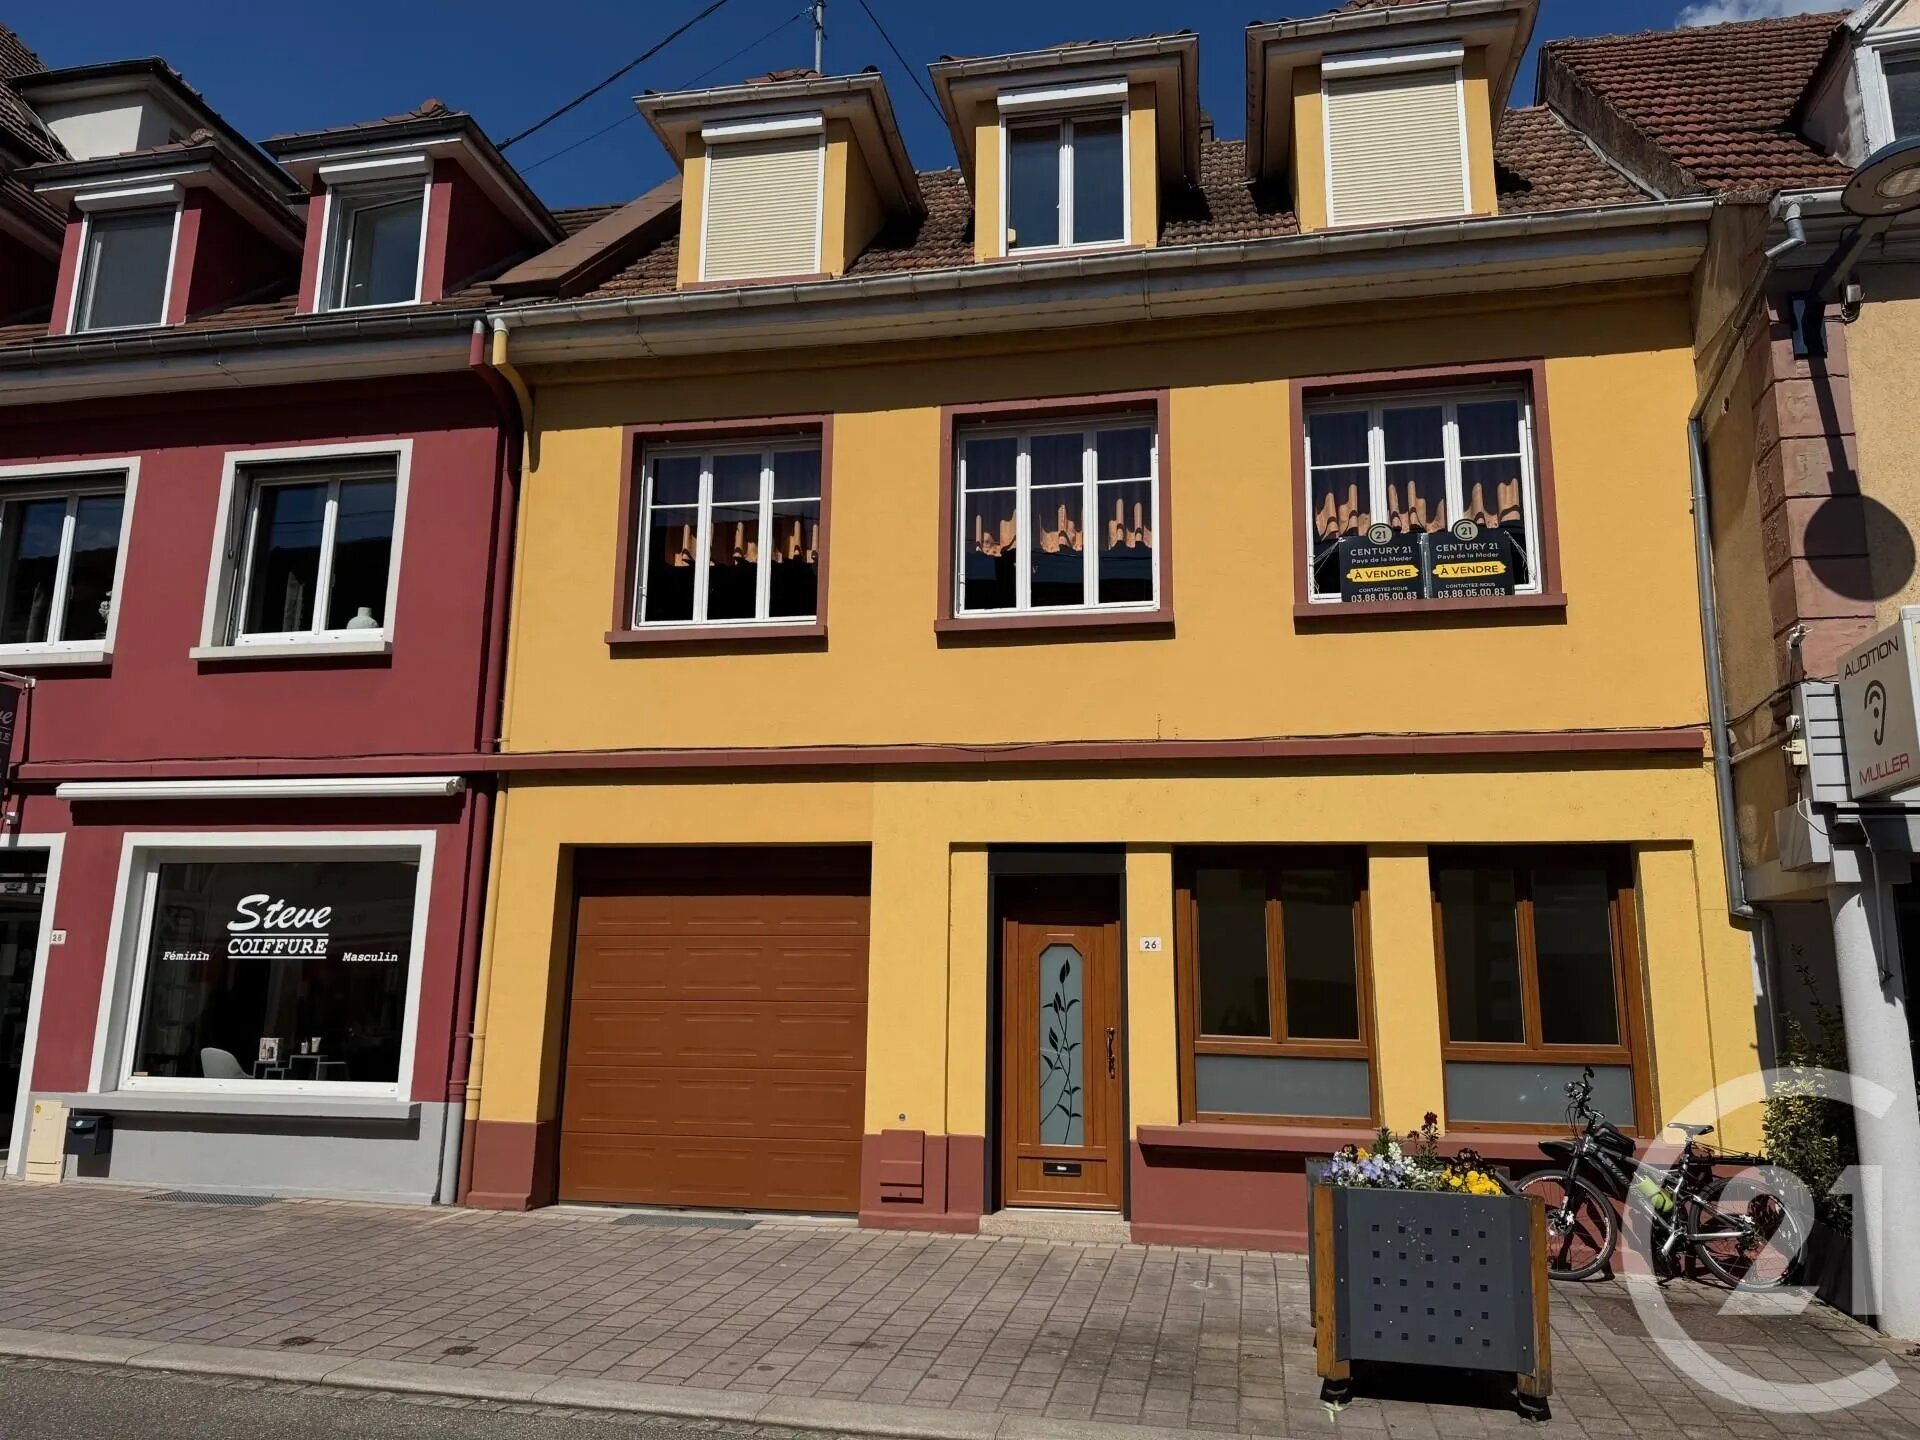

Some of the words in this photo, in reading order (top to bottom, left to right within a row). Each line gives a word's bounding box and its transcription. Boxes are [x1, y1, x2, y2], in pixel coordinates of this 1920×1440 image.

[1375, 531, 1386, 539] 21
[1461, 527, 1472, 535] 21
[1350, 547, 1400, 556] CENTURY
[1402, 546, 1412, 554] 21
[1436, 543, 1486, 552] CENTURY
[1488, 542, 1498, 550] 21
[1354, 570, 1362, 580] À
[1365, 569, 1412, 578] VENDRE
[1440, 565, 1449, 575] À
[1451, 565, 1499, 574] VENDRE
[1351, 592, 1417, 602] 03.88.05.00.83
[1437, 588, 1505, 598] 03.88.05.00.83
[1844, 636, 1899, 679] AUDITION
[1859, 752, 1910, 785] MULLER
[226, 893, 332, 931] Steve
[227, 937, 329, 955] COIFFURE
[1144, 940, 1157, 949] 26
[162, 951, 211, 962] Féminin
[341, 951, 399, 963] Masculin
